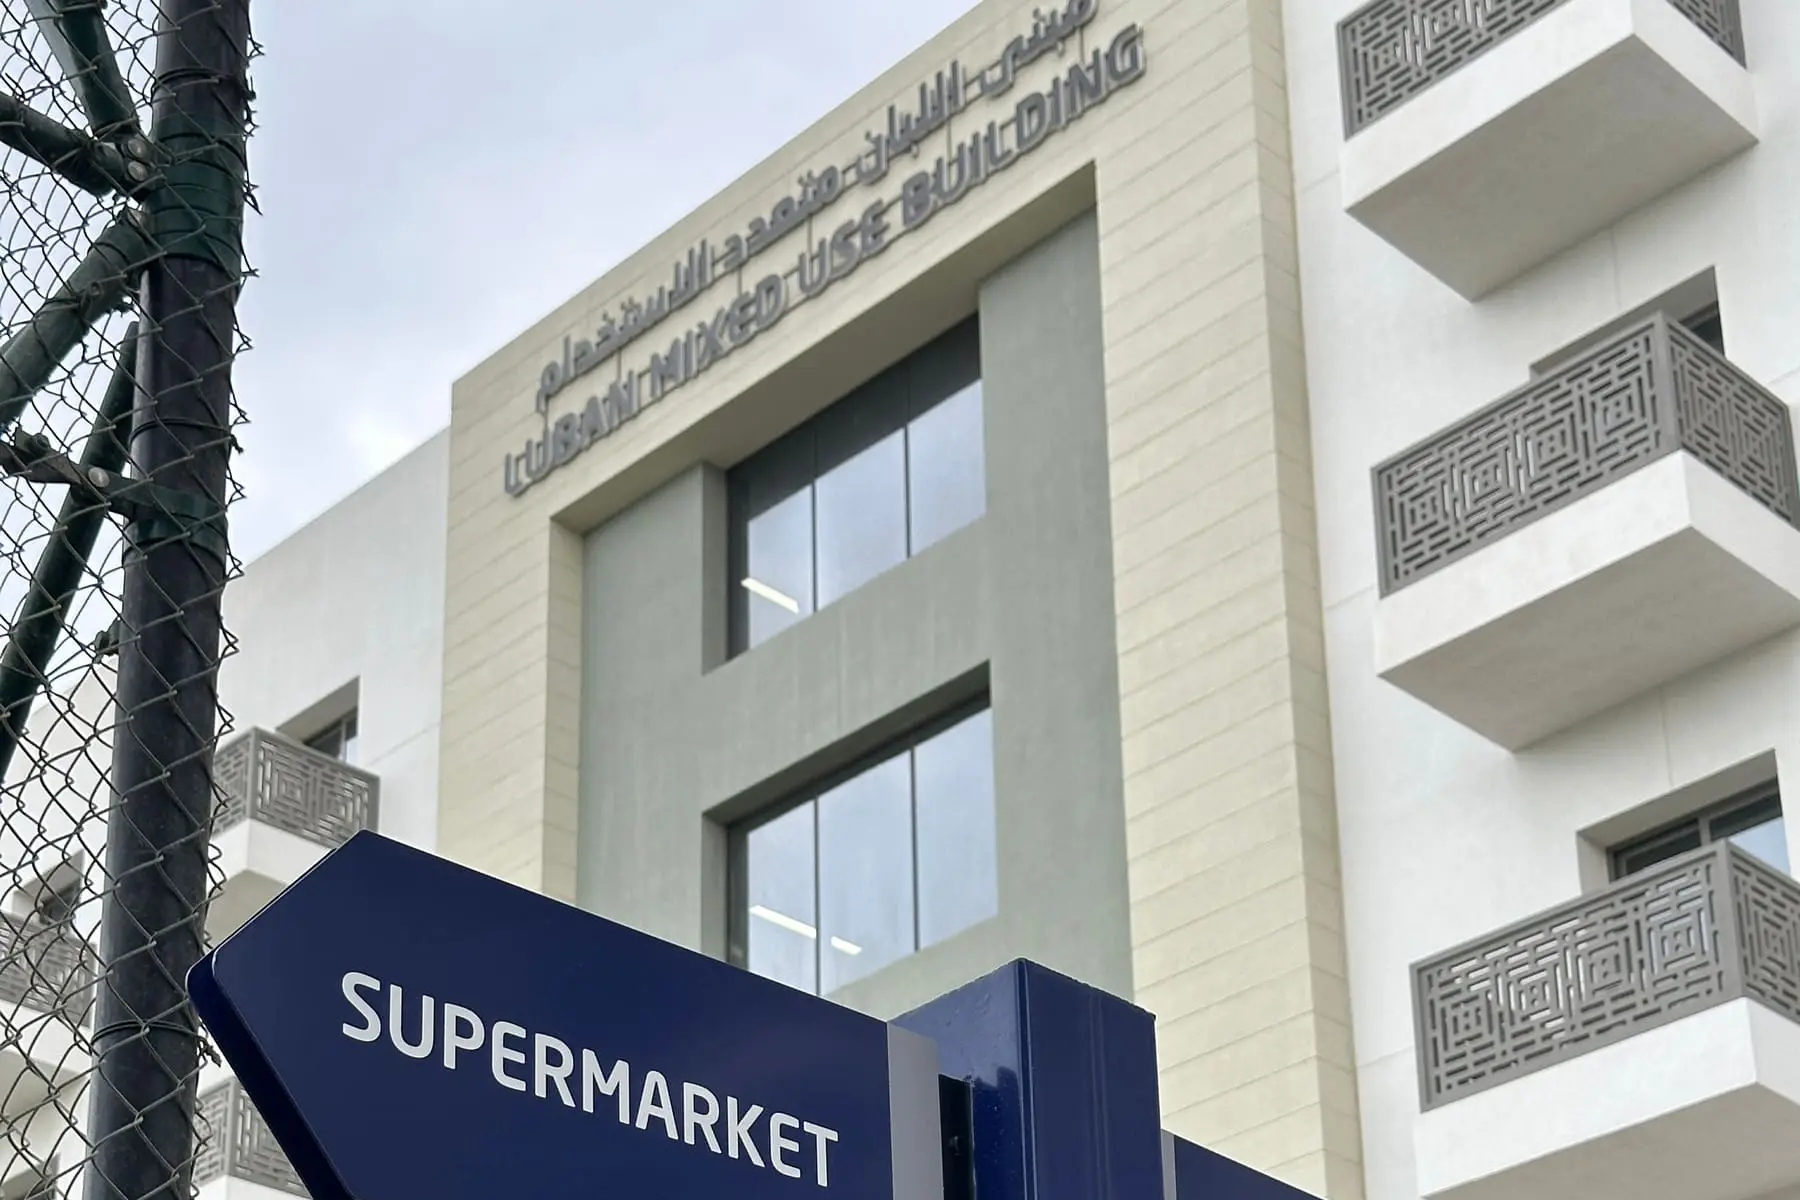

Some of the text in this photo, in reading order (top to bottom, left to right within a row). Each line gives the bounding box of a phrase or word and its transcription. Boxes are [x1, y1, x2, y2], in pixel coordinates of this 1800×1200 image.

[855, 59, 966, 187] اللبان
[504, 22, 1146, 497] LUBAN MIXED USE BUILDING
[722, 166, 841, 270] متعدد
[535, 238, 714, 415] الاستخدام
[340, 970, 840, 1188] SUPERMARKET
